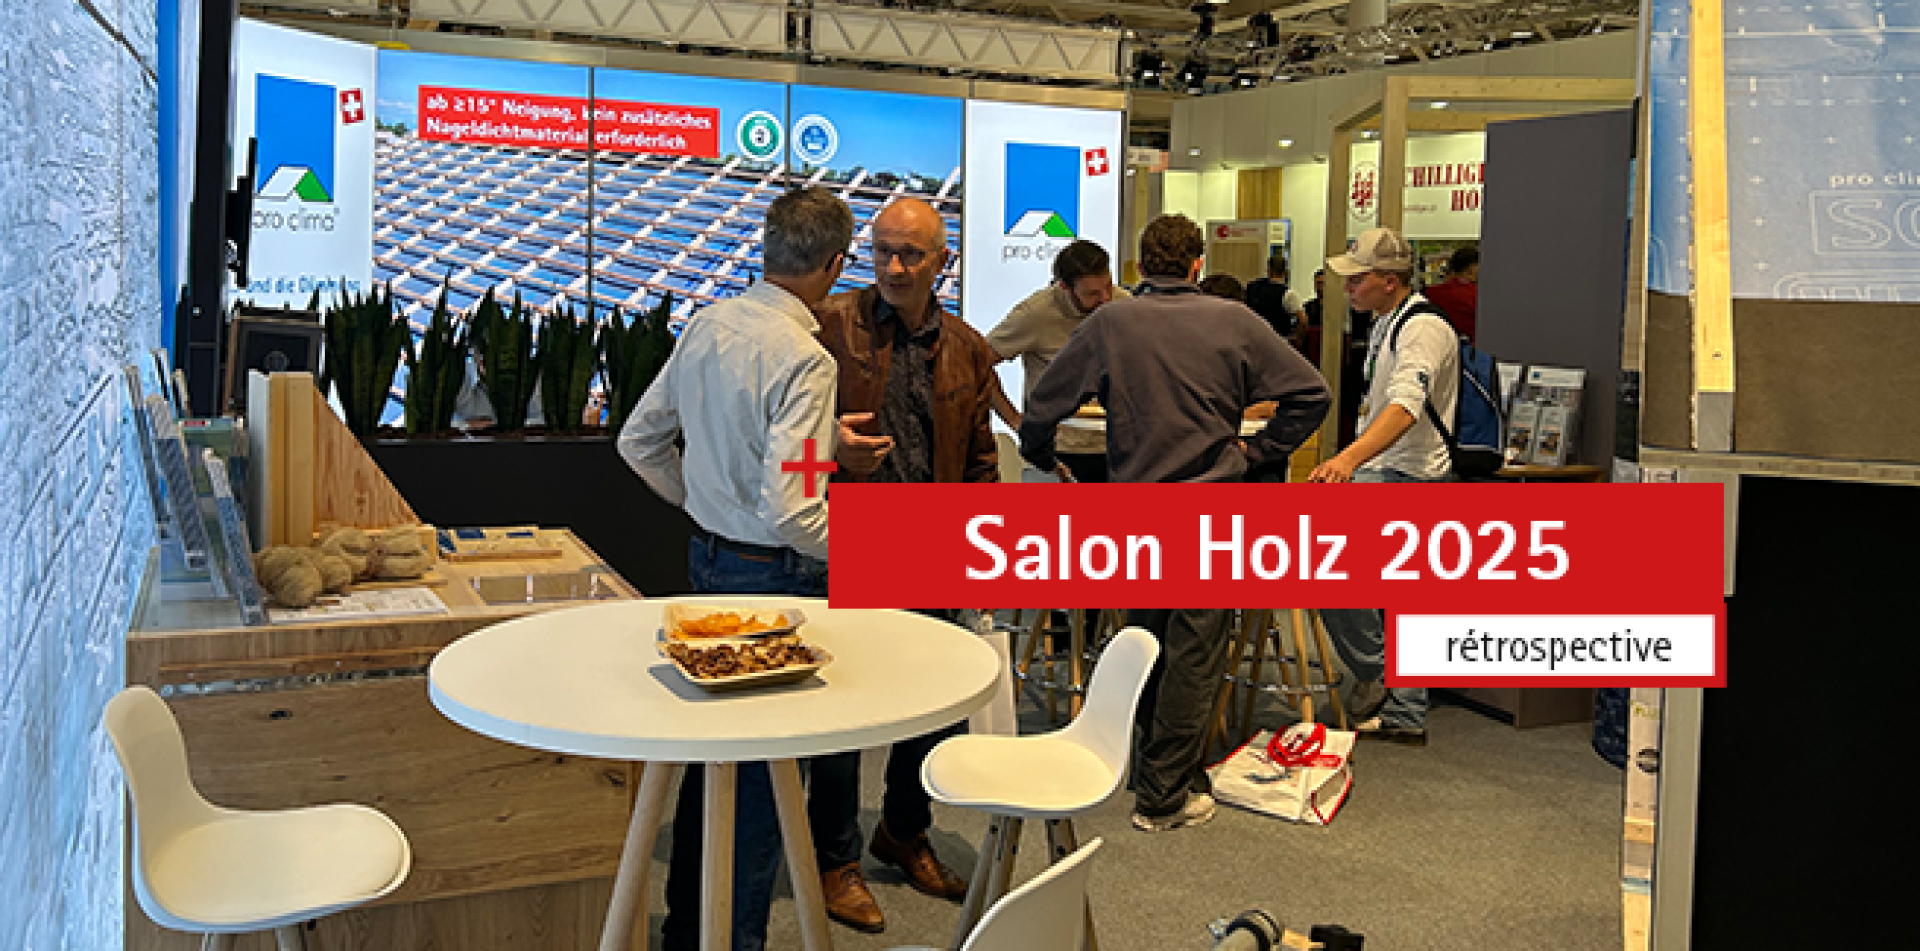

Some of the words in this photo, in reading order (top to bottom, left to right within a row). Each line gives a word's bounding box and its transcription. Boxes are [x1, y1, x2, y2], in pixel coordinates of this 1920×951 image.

[426, 93, 448, 111] ab
[620, 108, 712, 130] zusätzliches
[426, 116, 589, 144] Nageldichtmaterial
[595, 128, 687, 150] erforderlich
[1828, 172, 1875, 188] pro
[1450, 189, 1480, 212] HO
[1000, 243, 1031, 264] pro
